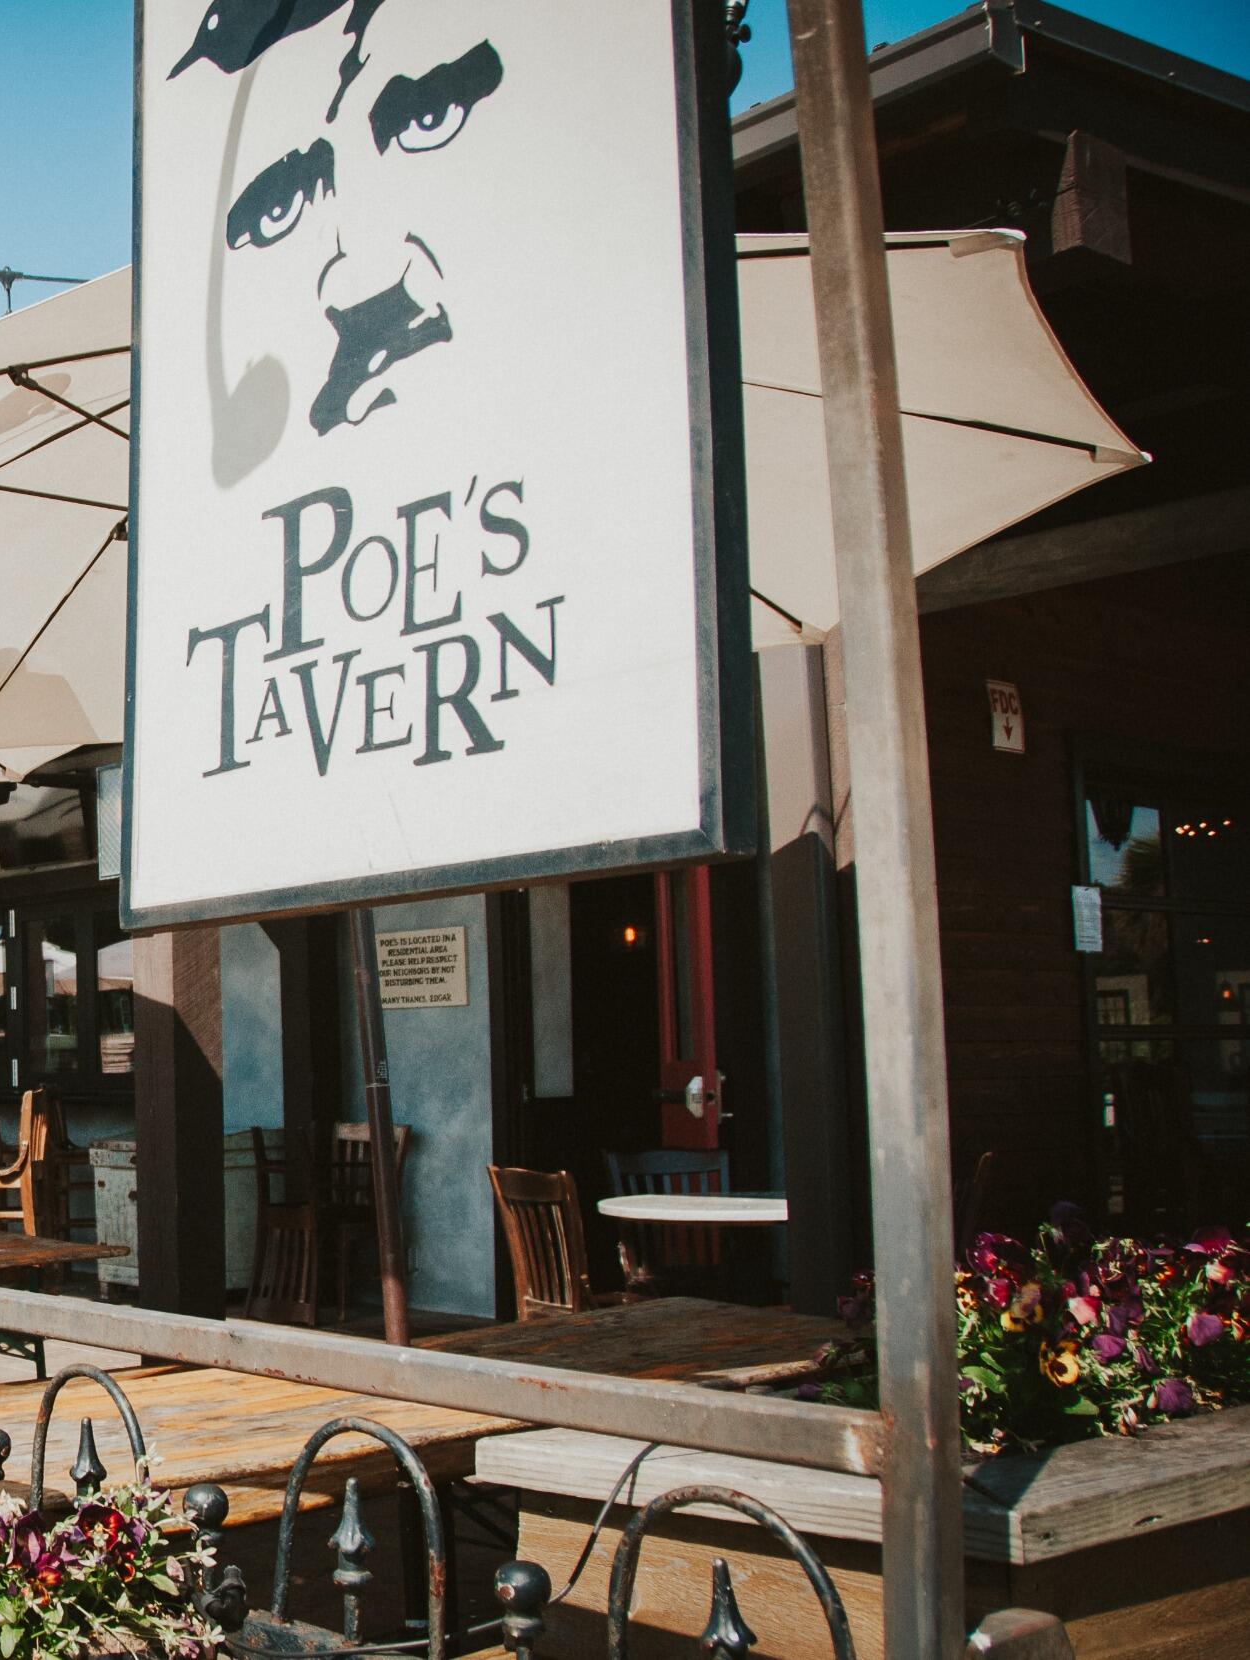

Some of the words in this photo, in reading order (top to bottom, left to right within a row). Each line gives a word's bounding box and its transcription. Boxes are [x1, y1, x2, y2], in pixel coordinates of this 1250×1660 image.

[262, 475, 529, 663] POE'S
[186, 595, 565, 778] TAVERN
[990, 688, 1018, 715] FDC
[400, 936, 408, 945] IS
[408, 935, 441, 945] LOCATED
[442, 934, 450, 942] IN
[451, 933, 456, 941] A
[388, 946, 428, 956] RESIDENTIAL
[430, 945, 448, 953] AREA
[382, 958, 407, 967] PLEASE
[408, 957, 425, 965] HELP
[426, 954, 458, 964] RESPECT
[379, 969, 391, 977] OUR
[393, 967, 430, 976] NEIGHBORS
[385, 977, 424, 987] DISTURBING
[382, 996, 400, 1005] MANY
[430, 993, 452, 1003] EDGAR
